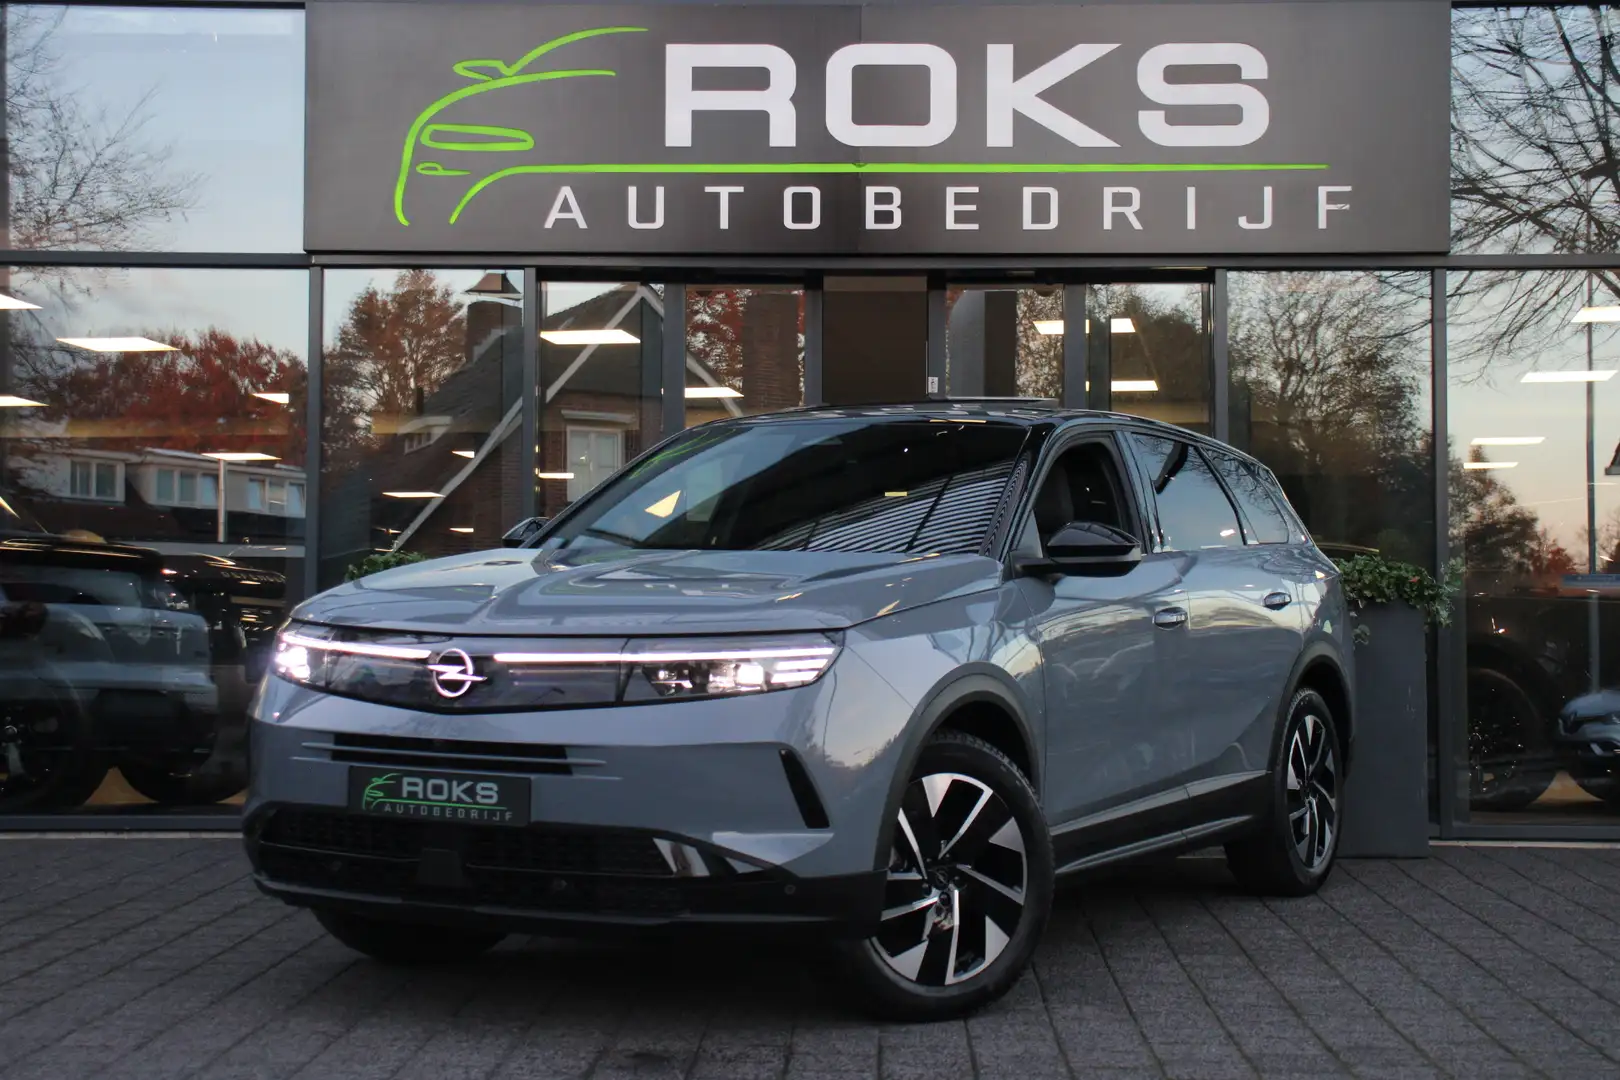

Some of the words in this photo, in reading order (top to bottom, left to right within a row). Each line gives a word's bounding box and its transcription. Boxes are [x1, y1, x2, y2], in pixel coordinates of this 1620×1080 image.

[666, 42, 1270, 148] ROKS
[543, 185, 1353, 231] AUTOBEDRIJF
[402, 776, 499, 804] ROKS
[384, 803, 513, 821] AUTOBEDRIJF
